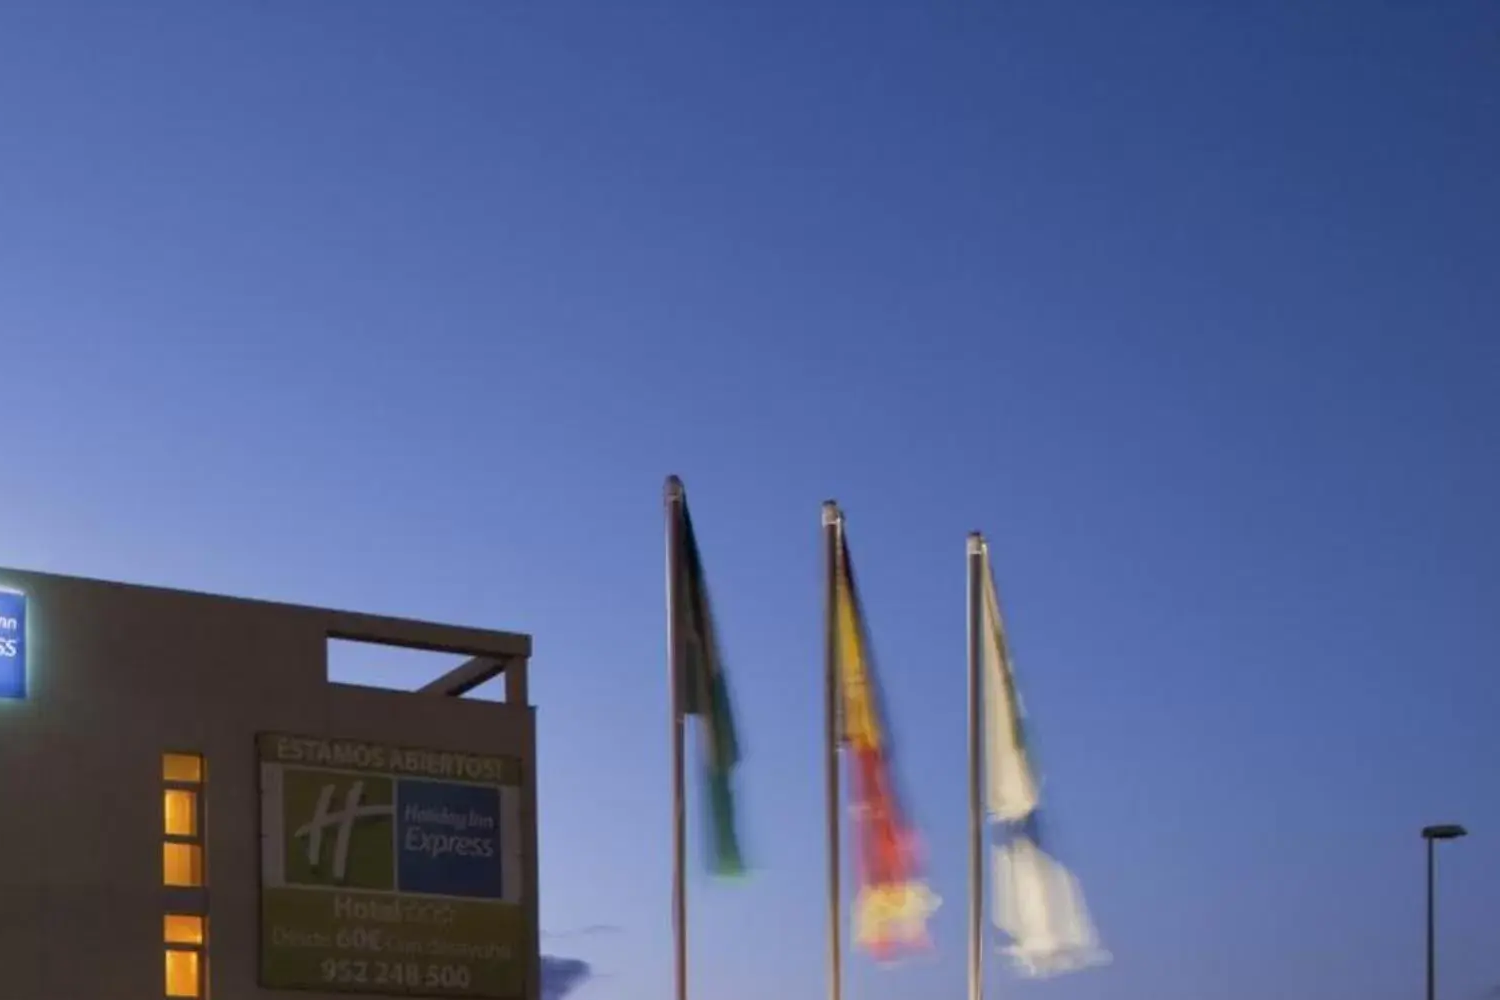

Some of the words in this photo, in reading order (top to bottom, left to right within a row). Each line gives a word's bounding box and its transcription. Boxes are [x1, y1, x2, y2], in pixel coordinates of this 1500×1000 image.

[277, 738, 384, 768] ESTAMOS
[405, 827, 493, 857] Express
[320, 958, 368, 983] 952
[424, 966, 470, 989] 500
